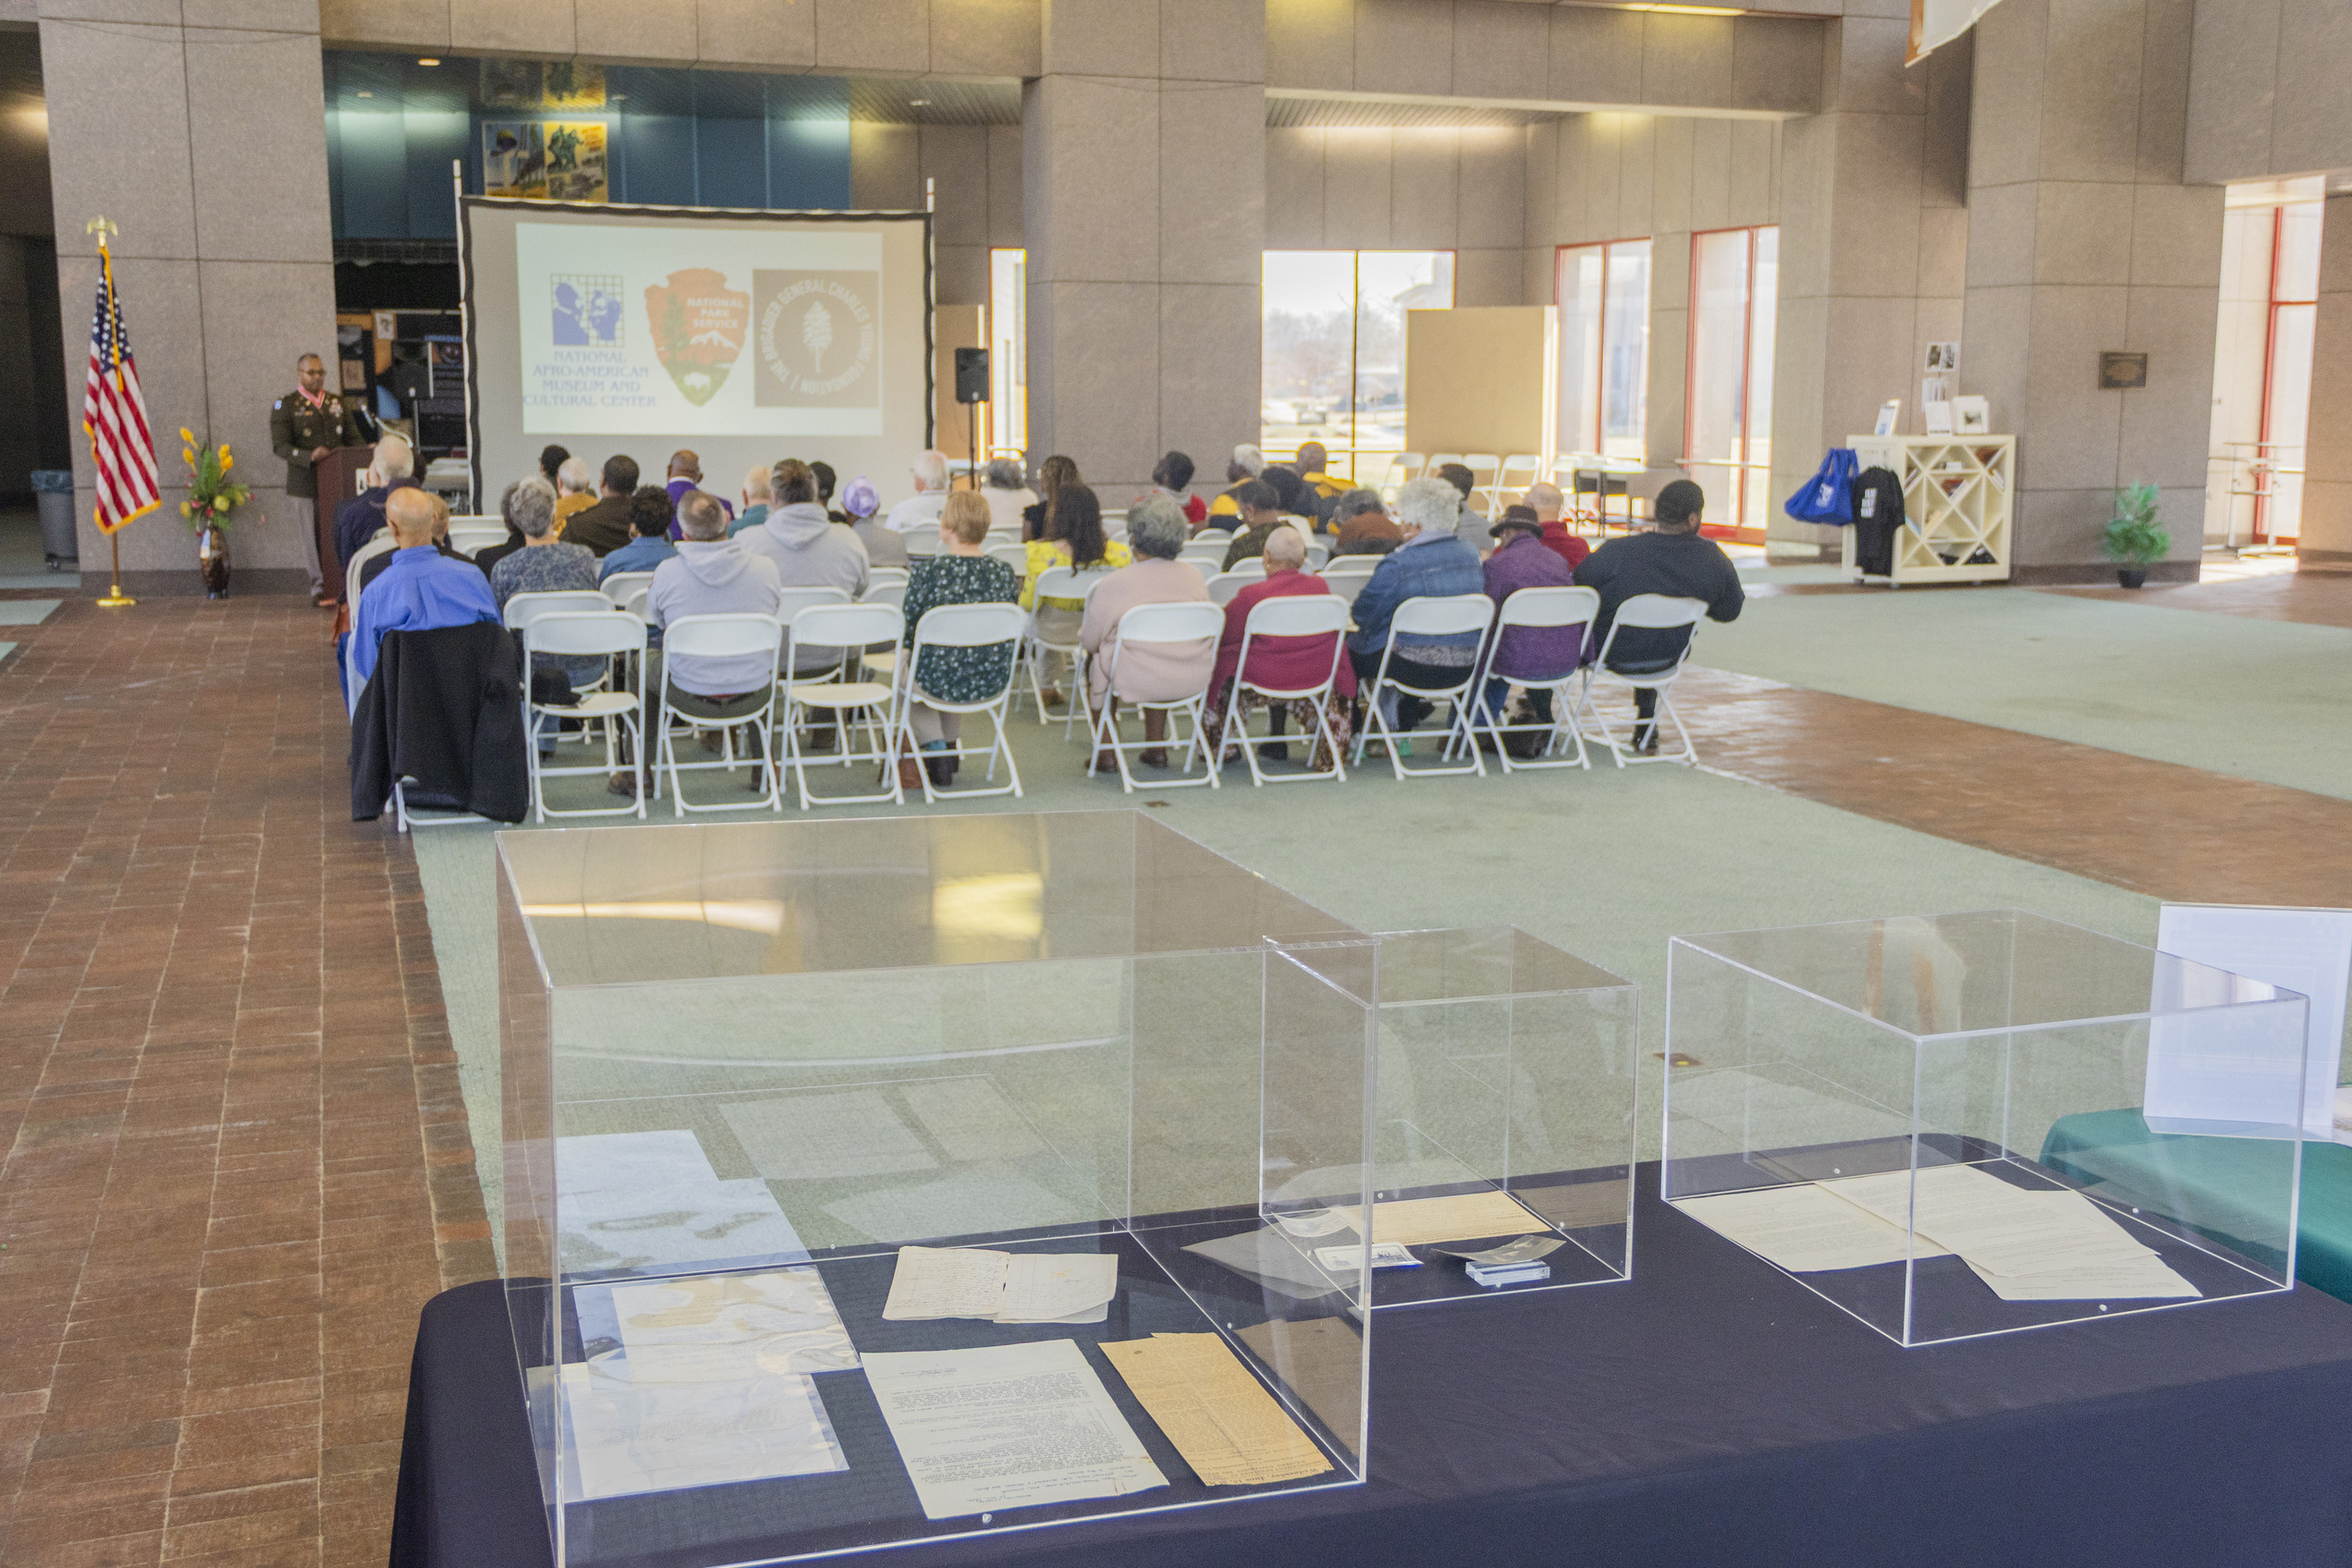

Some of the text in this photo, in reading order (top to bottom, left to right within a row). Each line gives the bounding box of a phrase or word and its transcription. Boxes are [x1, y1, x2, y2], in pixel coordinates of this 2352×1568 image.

[687, 298, 743, 308] NATIONAL
[778, 278, 826, 305] GENERAL
[828, 281, 871, 323] CHARLES
[701, 309, 729, 317] PARK
[692, 319, 738, 328] SERVICE
[555, 351, 627, 362] NATIONAL
[533, 365, 649, 377] AFRO-AMERICAN
[543, 380, 641, 392] MUSEUM AND
[523, 395, 655, 407] CULTURAL CENTER
